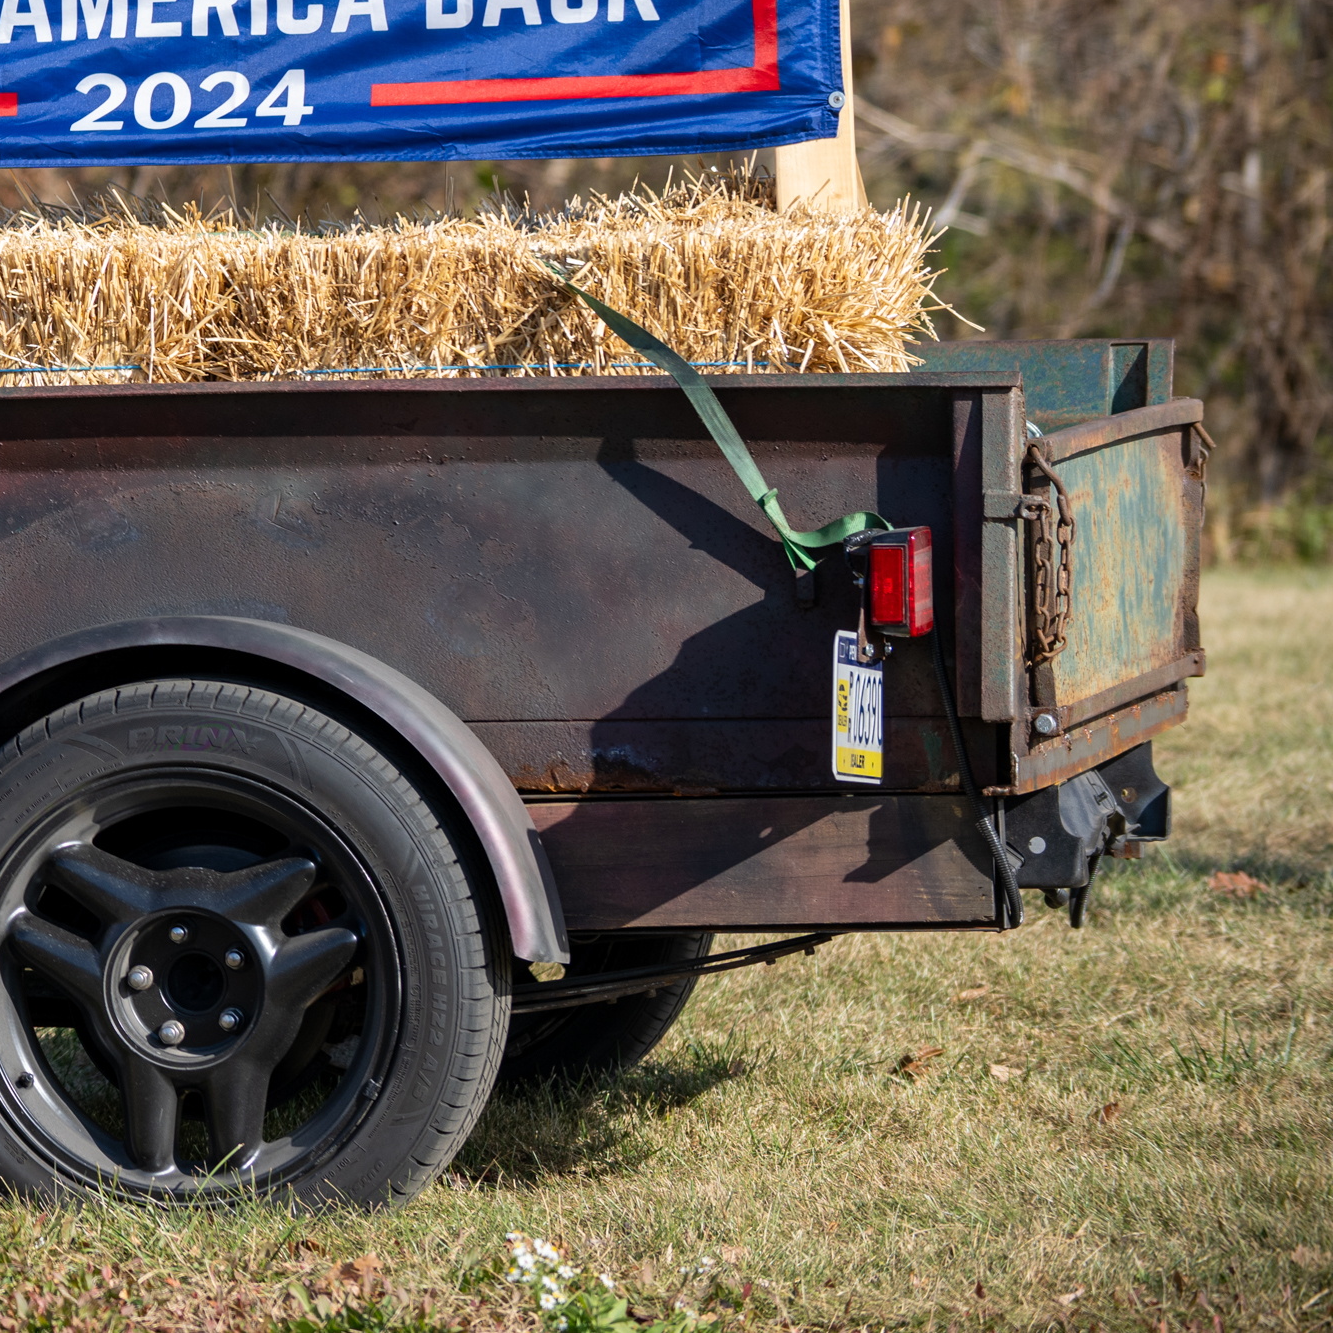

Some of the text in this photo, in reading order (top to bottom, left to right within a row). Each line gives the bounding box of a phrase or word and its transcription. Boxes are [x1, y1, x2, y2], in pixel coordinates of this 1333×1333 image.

[69, 68, 315, 133] 2024
[127, 724, 259, 755] PRINX
[428, 992, 447, 1047] HZ2
[412, 1051, 438, 1103] A/S
